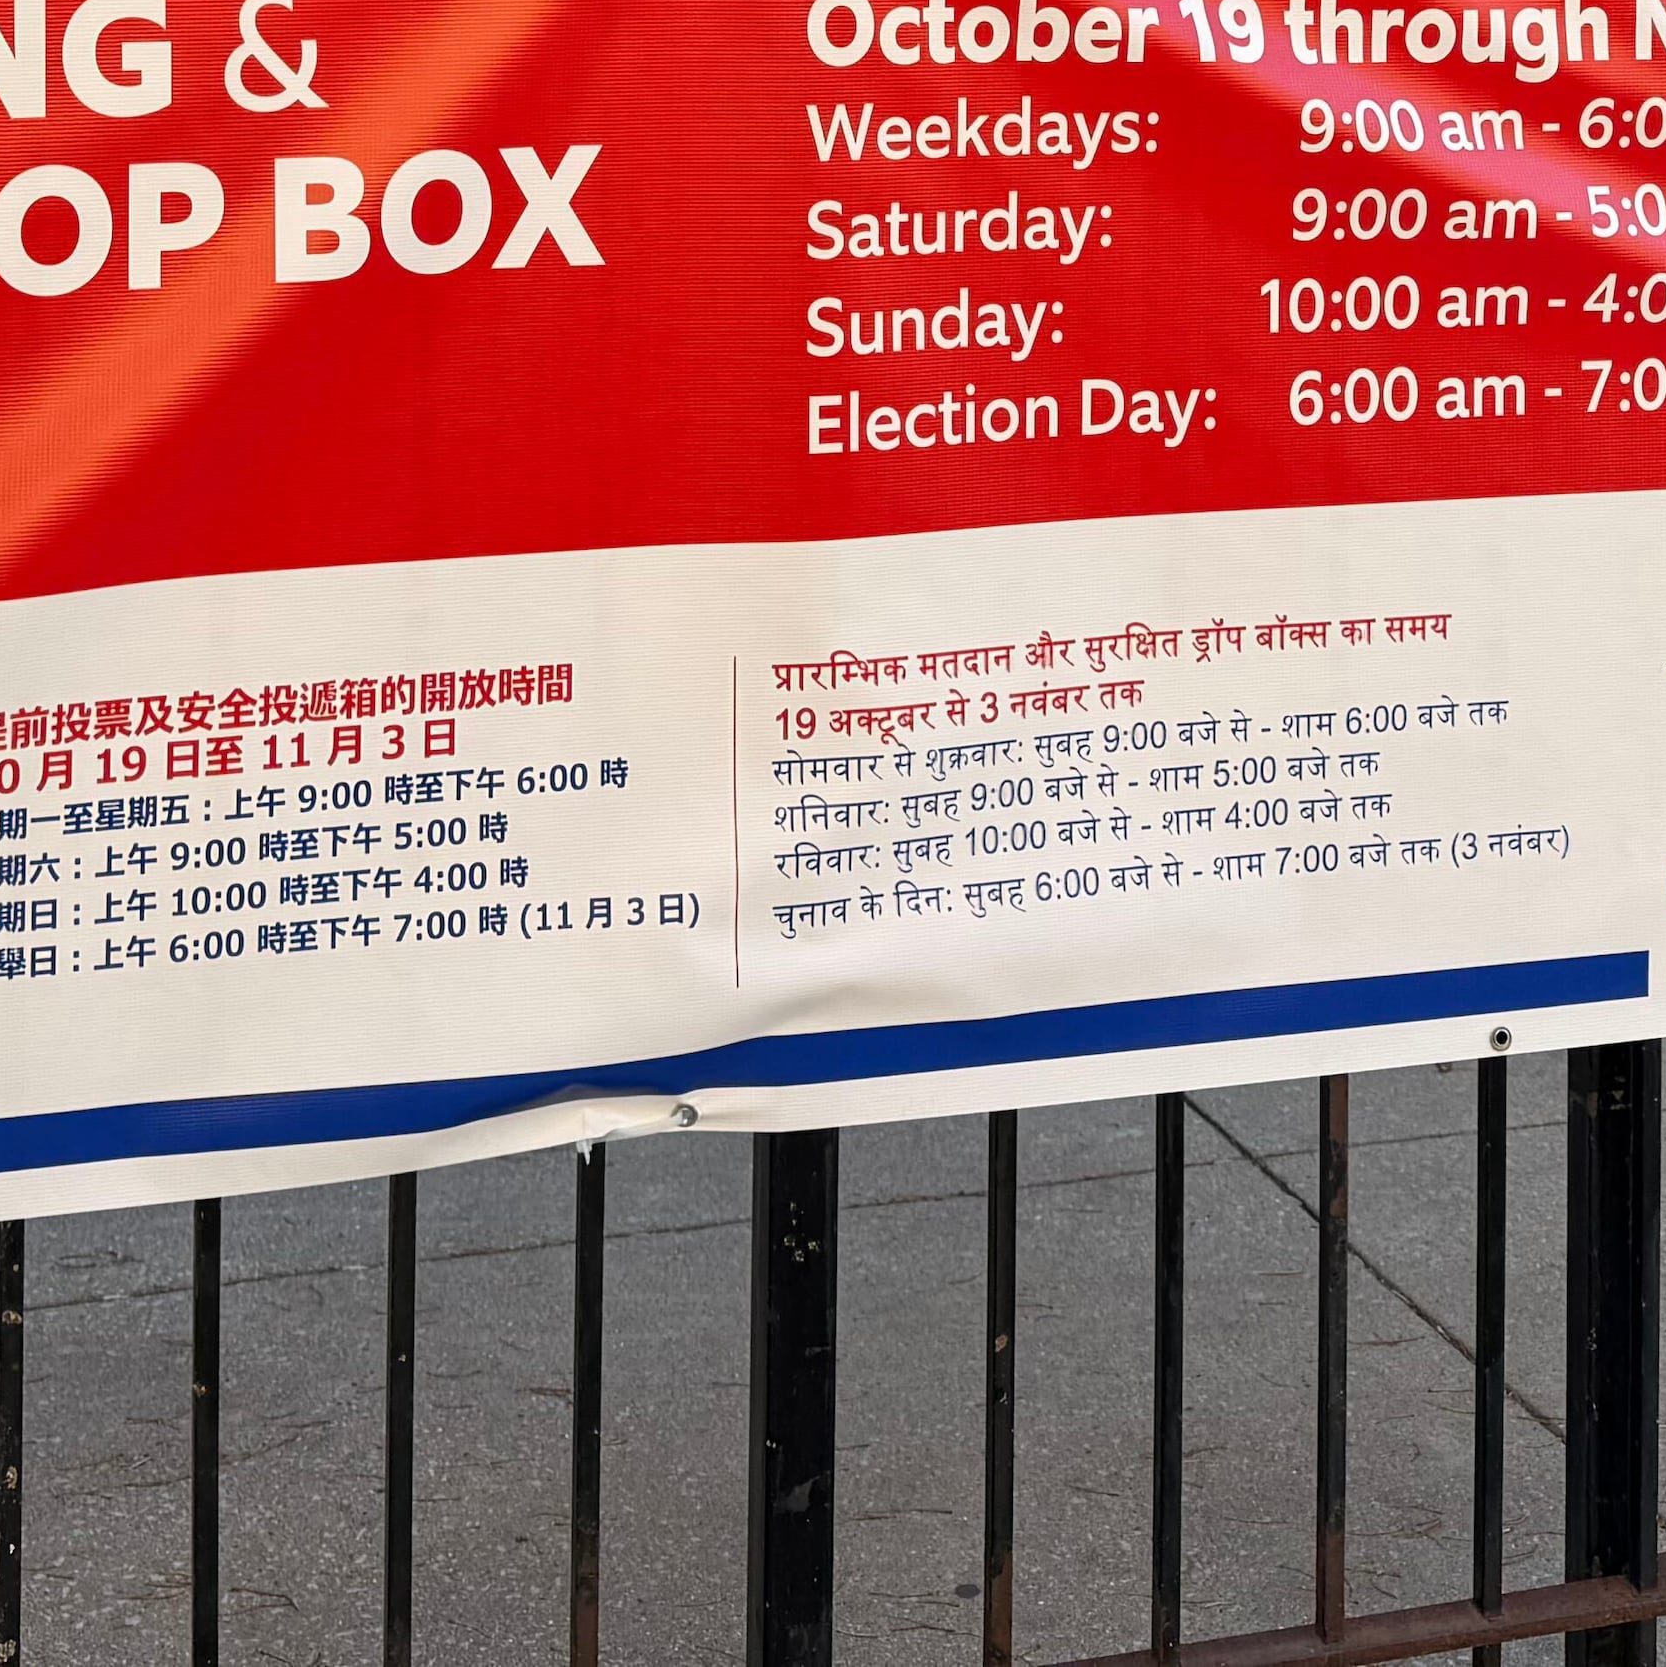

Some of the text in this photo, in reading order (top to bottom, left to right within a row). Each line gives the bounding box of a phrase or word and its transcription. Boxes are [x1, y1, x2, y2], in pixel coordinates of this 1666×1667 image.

[807, 97, 1158, 169] Weekdays:
[1301, 99, 1424, 152] 9:00
[1439, 111, 1523, 151] am
[275, 146, 604, 283] BOX
[808, 192, 1111, 264] Saturday:
[1293, 189, 1426, 240] 9:00
[1445, 200, 1536, 238] am
[808, 289, 1062, 361] Sunday:
[1262, 276, 1419, 332] 10:00
[1438, 287, 1527, 327] am
[810, 384, 1057, 453] Election
[1082, 380, 1215, 447] Day:
[1290, 368, 1417, 425] 6:00
[1437, 376, 1524, 418] am
[772, 614, 1452, 692] प्रारम्भिक मतदान और सुरक्षित ड्रॉप बॉक्स का समय
[776, 680, 1145, 745] 19 अक्टूबर से 3 नवंबर तक
